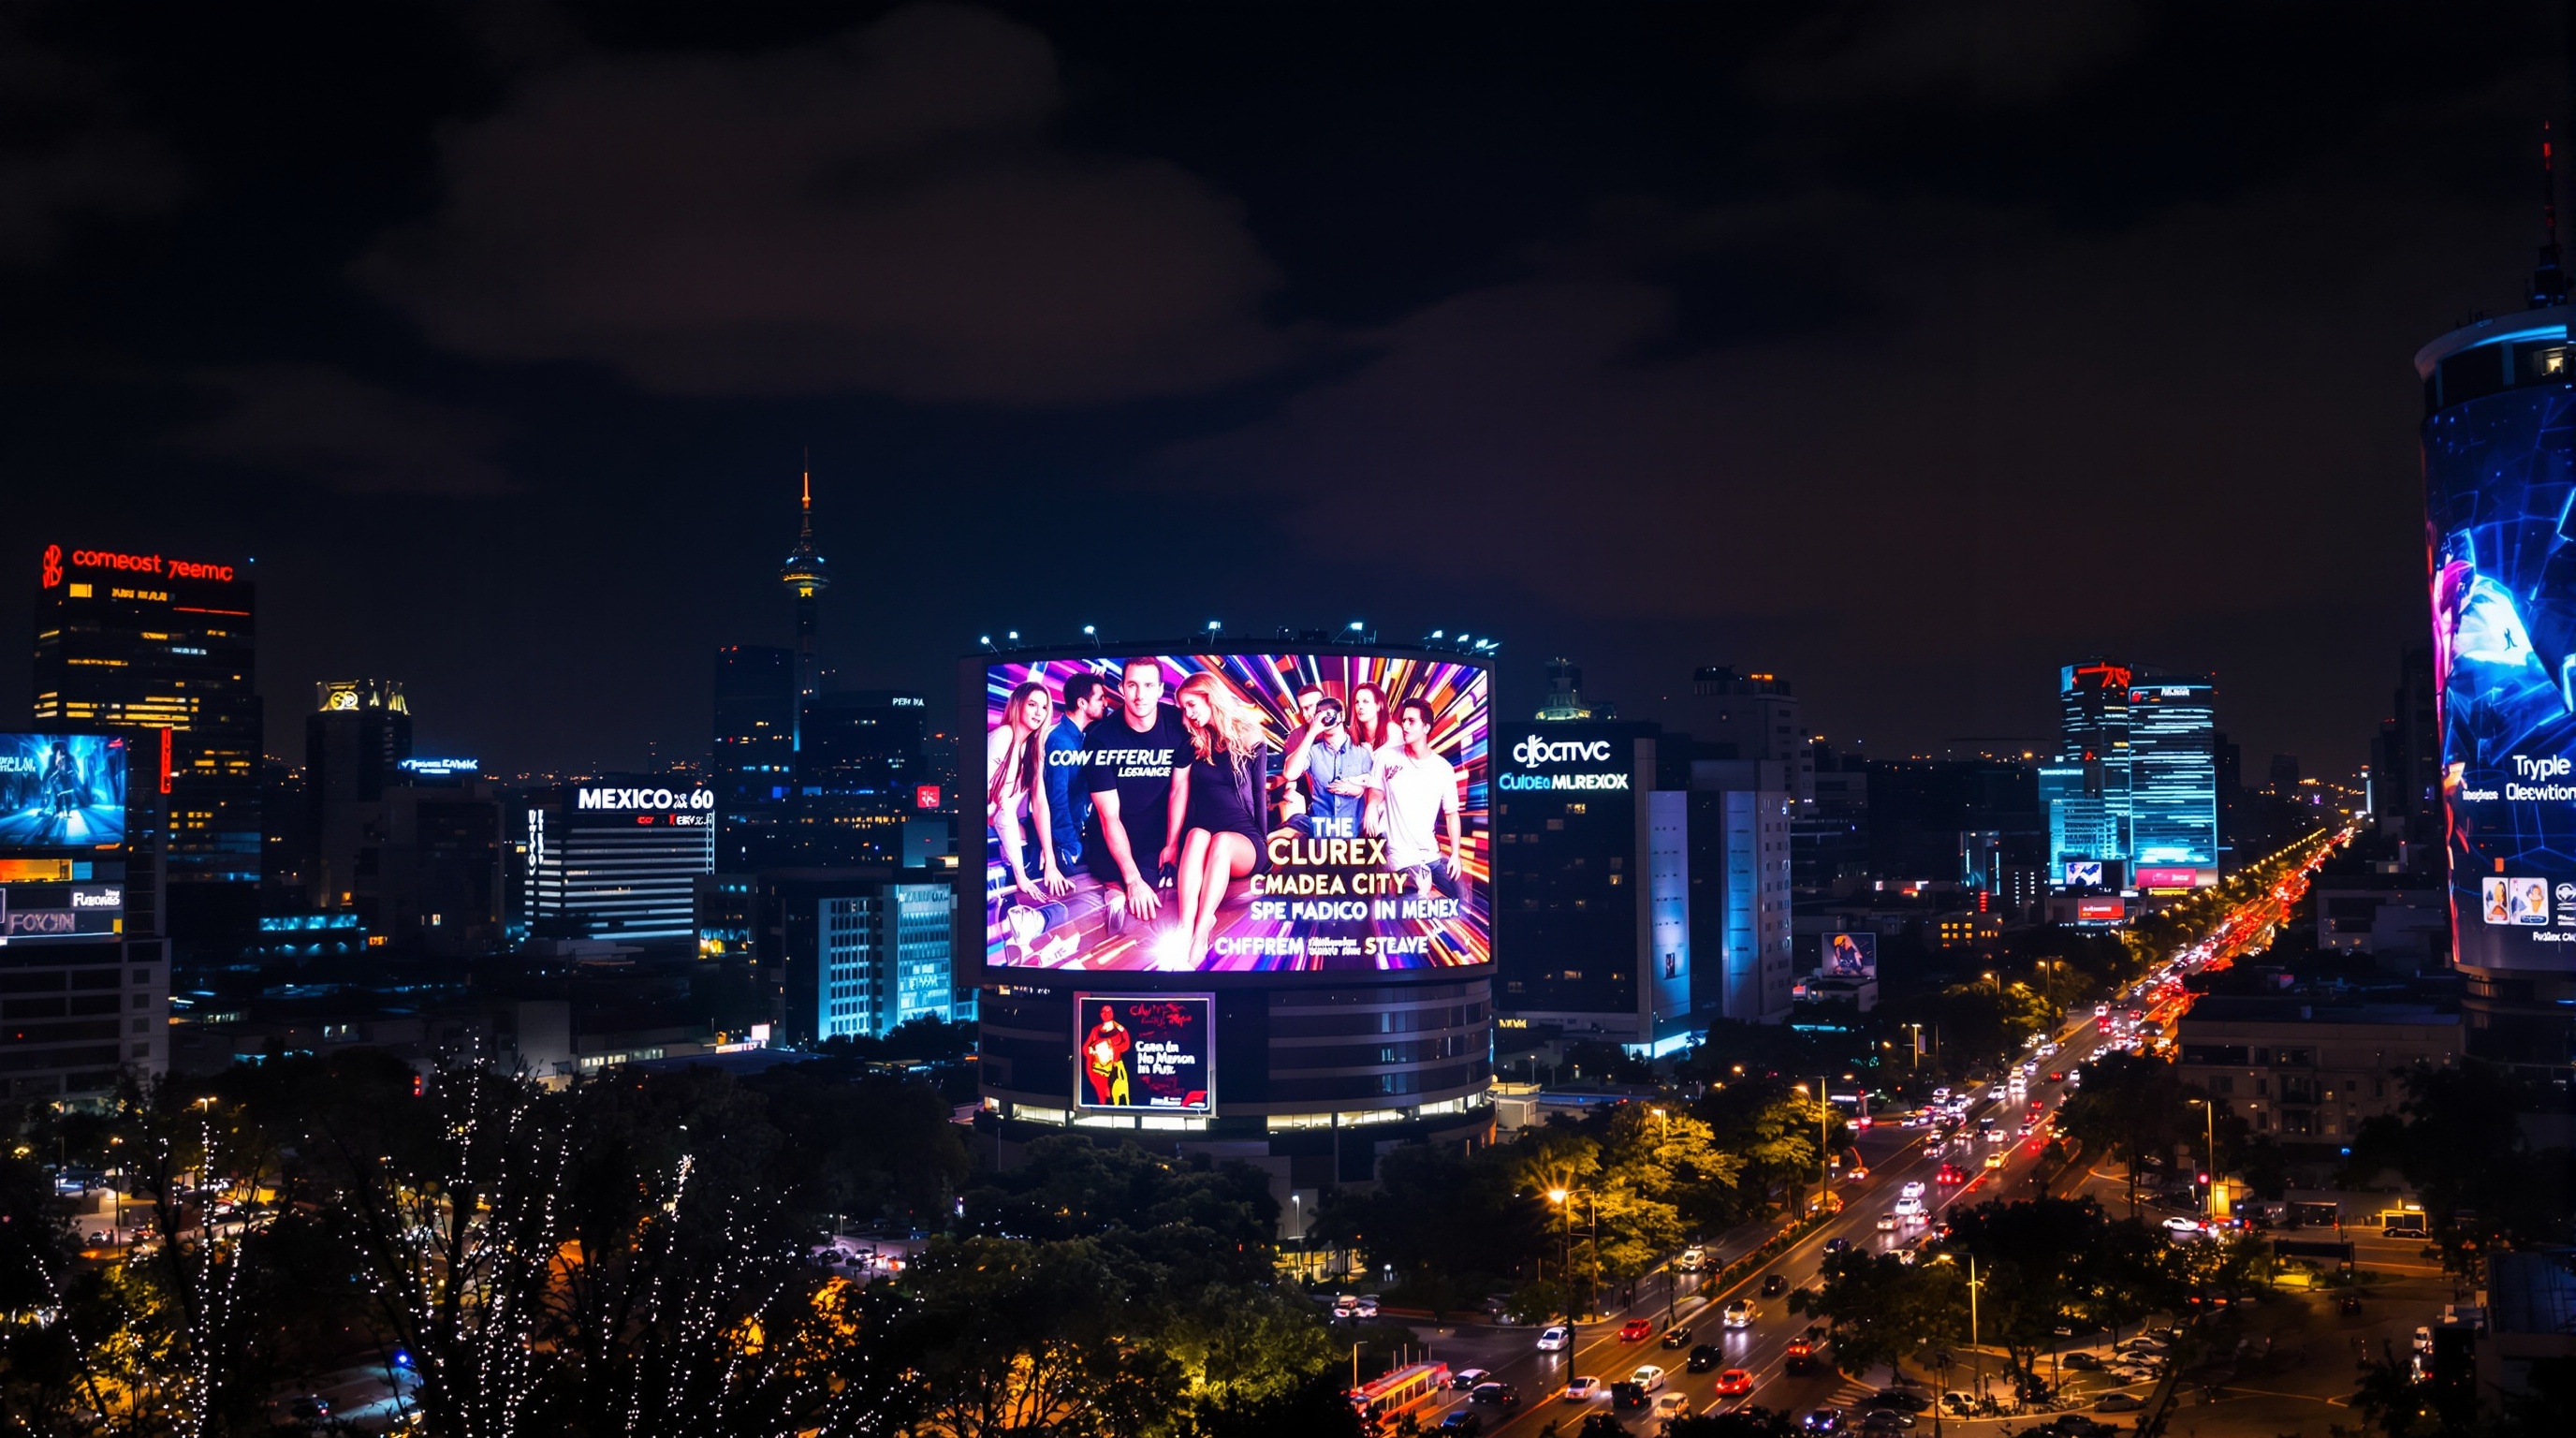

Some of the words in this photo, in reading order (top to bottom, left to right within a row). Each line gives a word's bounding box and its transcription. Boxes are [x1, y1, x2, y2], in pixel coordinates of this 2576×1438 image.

[2512, 755, 2571, 782] Tryple
[578, 788, 673, 810] MEXICO
[690, 789, 714, 809] 60
[1311, 816, 1353, 838] THE
[1267, 838, 1387, 866] CLUREX
[1352, 873, 1408, 895] CITY
[1251, 900, 1287, 920] SPE
[1375, 900, 1398, 919] IN
[1402, 899, 1459, 919] MENEX
